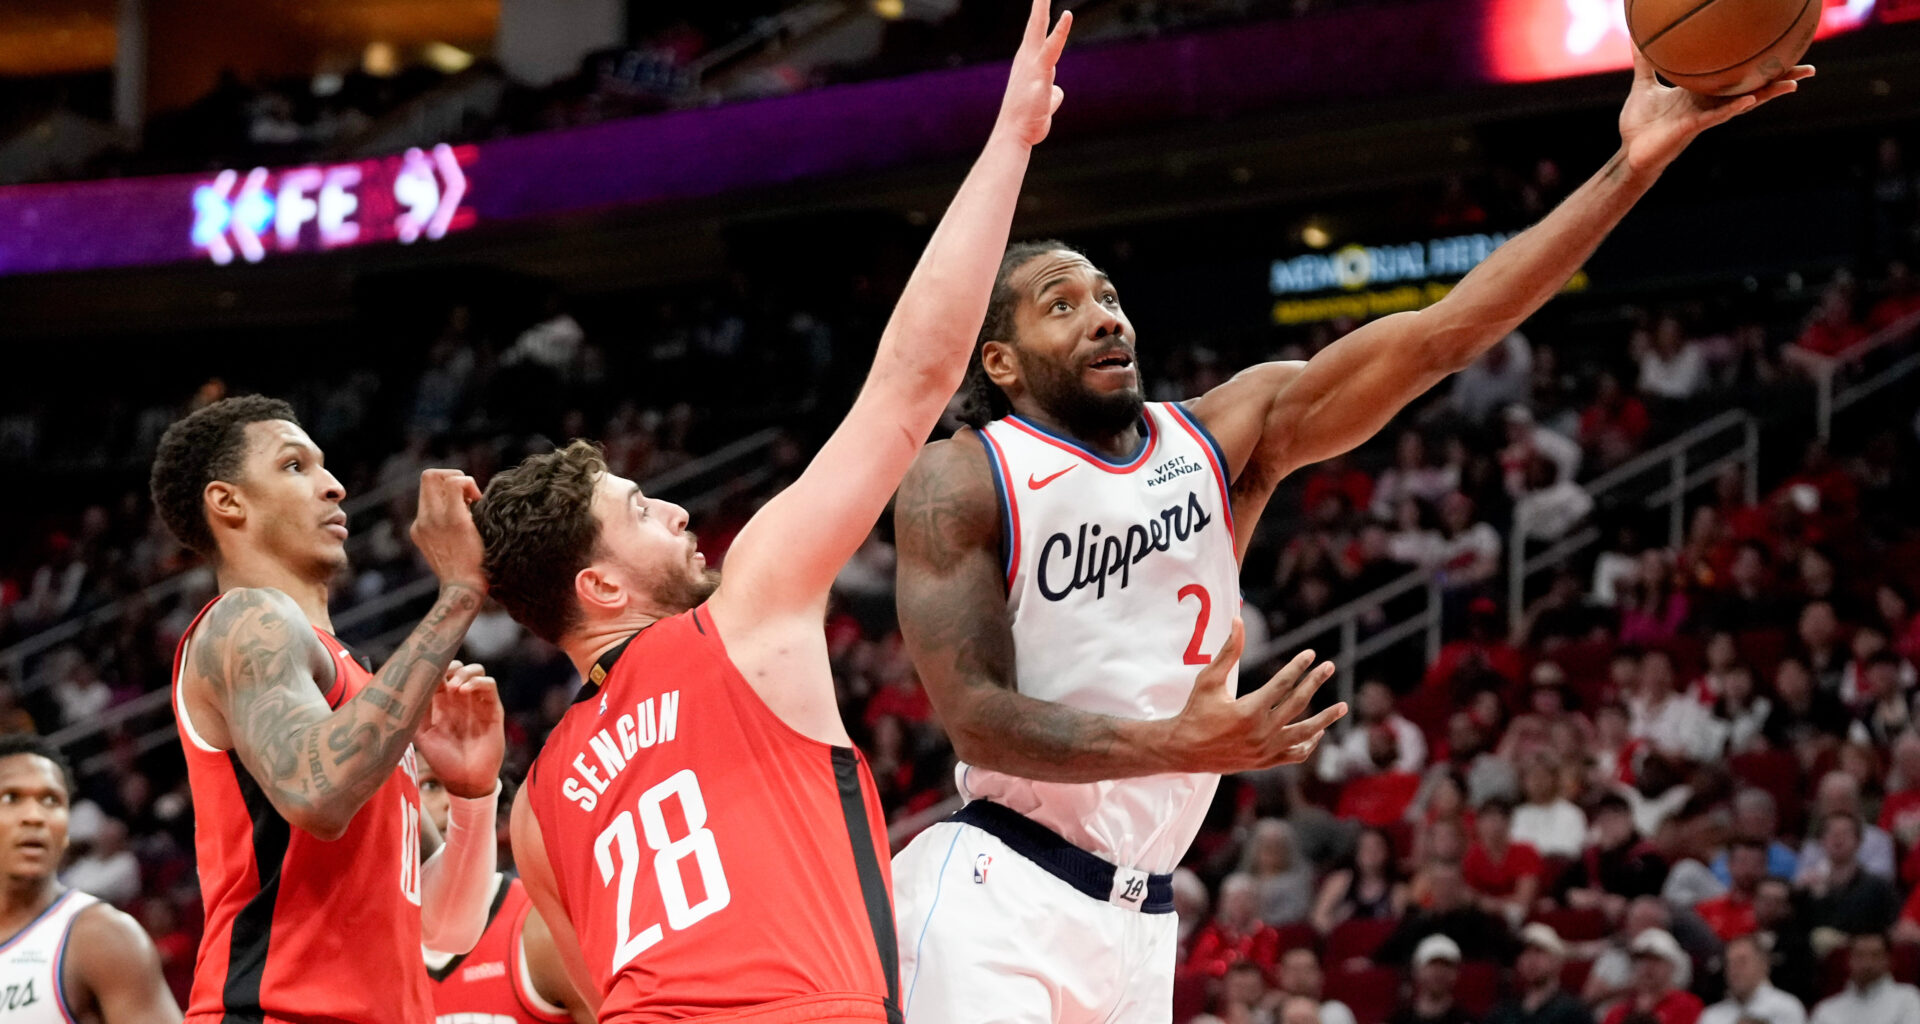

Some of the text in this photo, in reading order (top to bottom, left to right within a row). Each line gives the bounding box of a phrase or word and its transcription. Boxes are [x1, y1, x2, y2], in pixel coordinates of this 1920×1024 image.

[1146, 462, 1203, 487] RWANDA
[1154, 455, 1186, 475] VISIT
[1037, 491, 1211, 602] Clippers
[1177, 583, 1212, 666] 2
[562, 690, 680, 813] SENGUN
[593, 768, 731, 975] 28
[1119, 876, 1144, 902] LA
